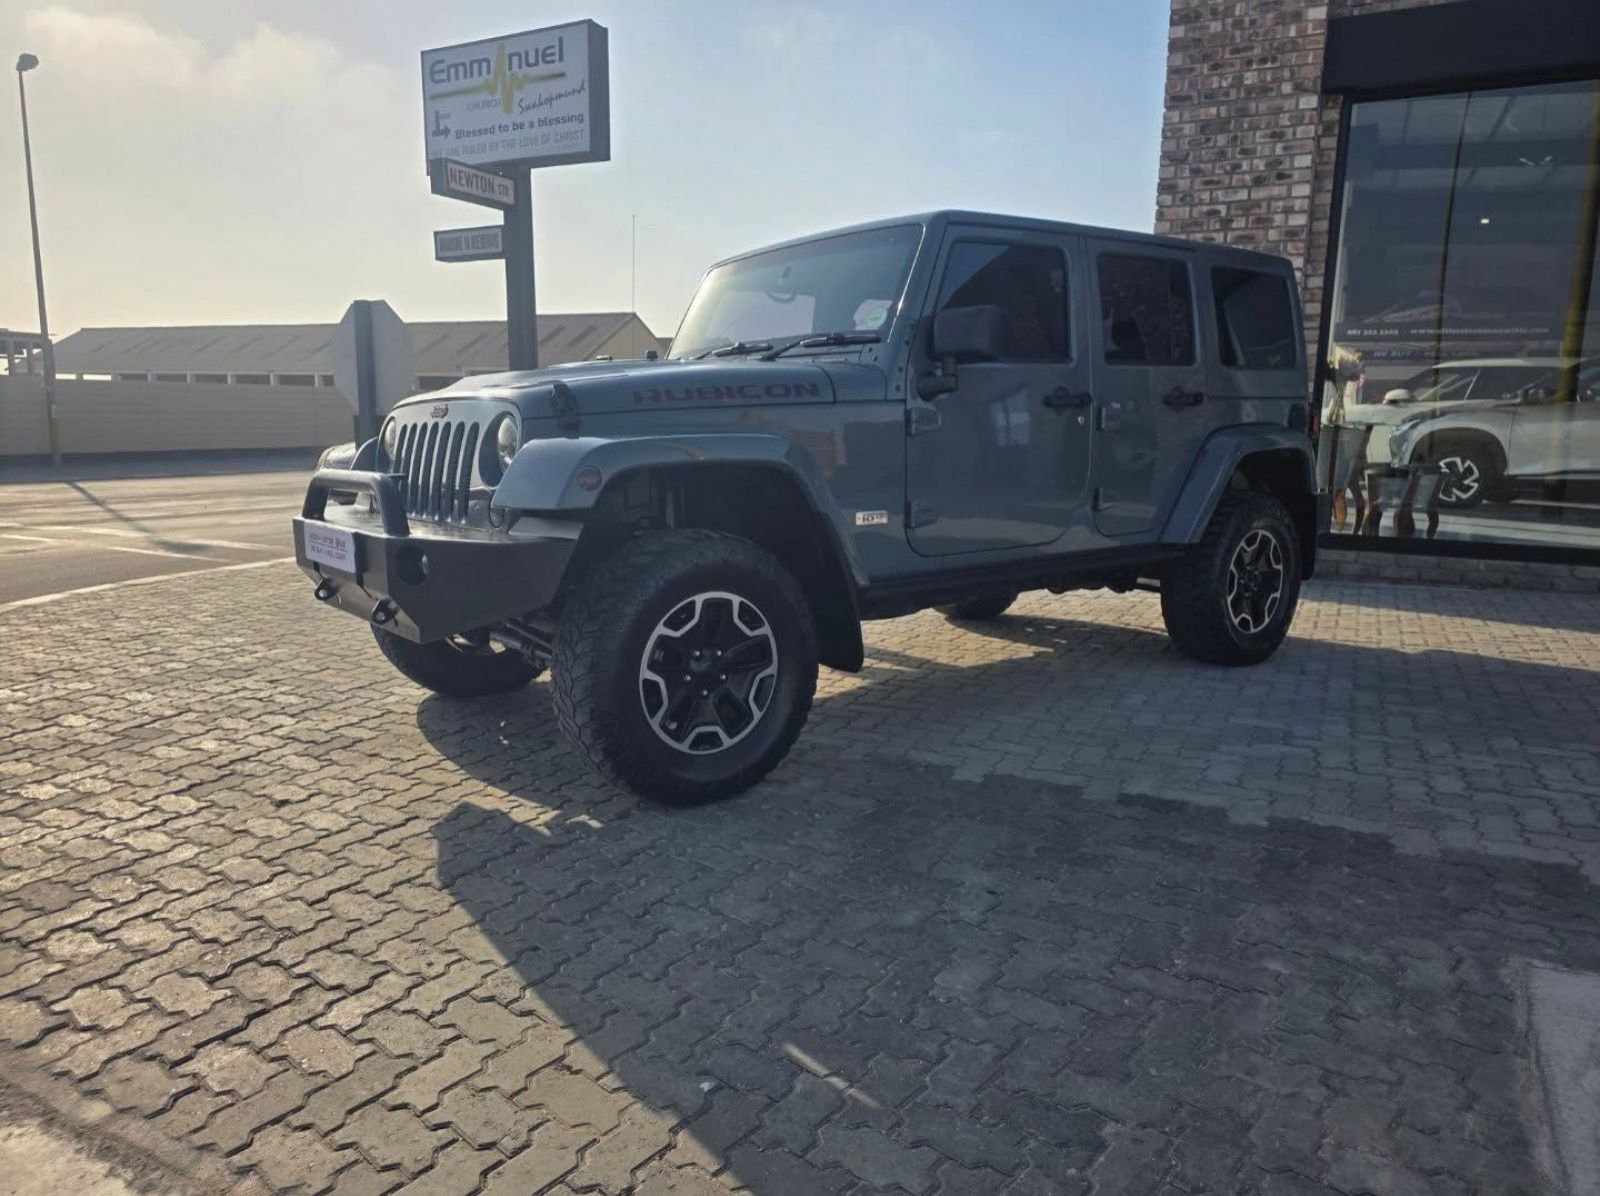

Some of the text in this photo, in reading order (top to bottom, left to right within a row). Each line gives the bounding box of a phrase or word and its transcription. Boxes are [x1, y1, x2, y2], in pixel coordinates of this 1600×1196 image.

[455, 112, 585, 139] Blessed to be a blessing
[502, 137, 518, 150] THE
[518, 135, 539, 148] LOVE
[449, 166, 496, 195] NEWTON
[632, 383, 820, 404] RUBICON
